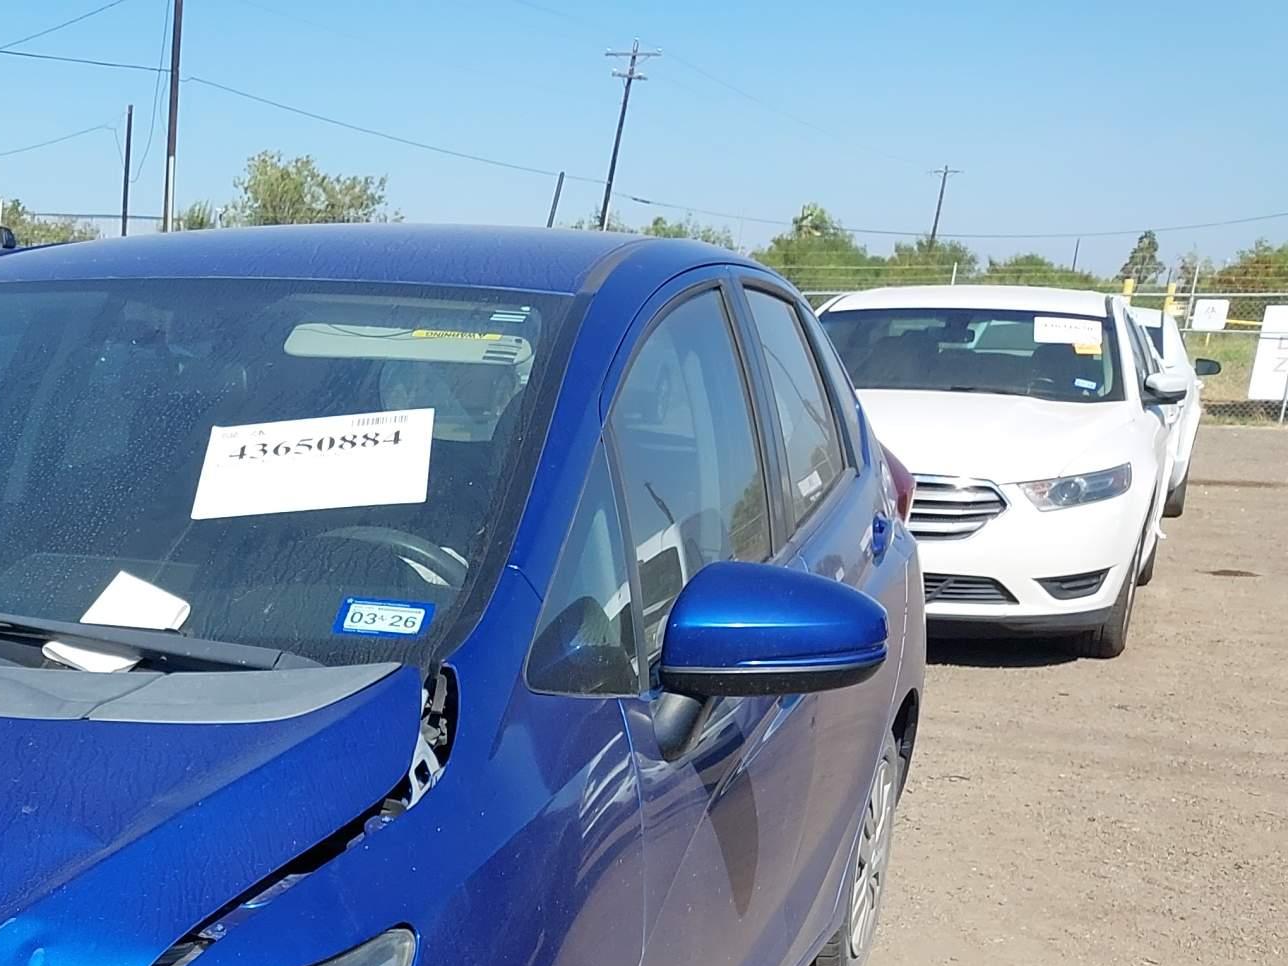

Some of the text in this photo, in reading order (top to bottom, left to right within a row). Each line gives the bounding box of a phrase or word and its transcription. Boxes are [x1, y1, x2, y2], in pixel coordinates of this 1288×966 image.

[228, 429, 403, 461] 43650884
[349, 611, 418, 629] 03 26
